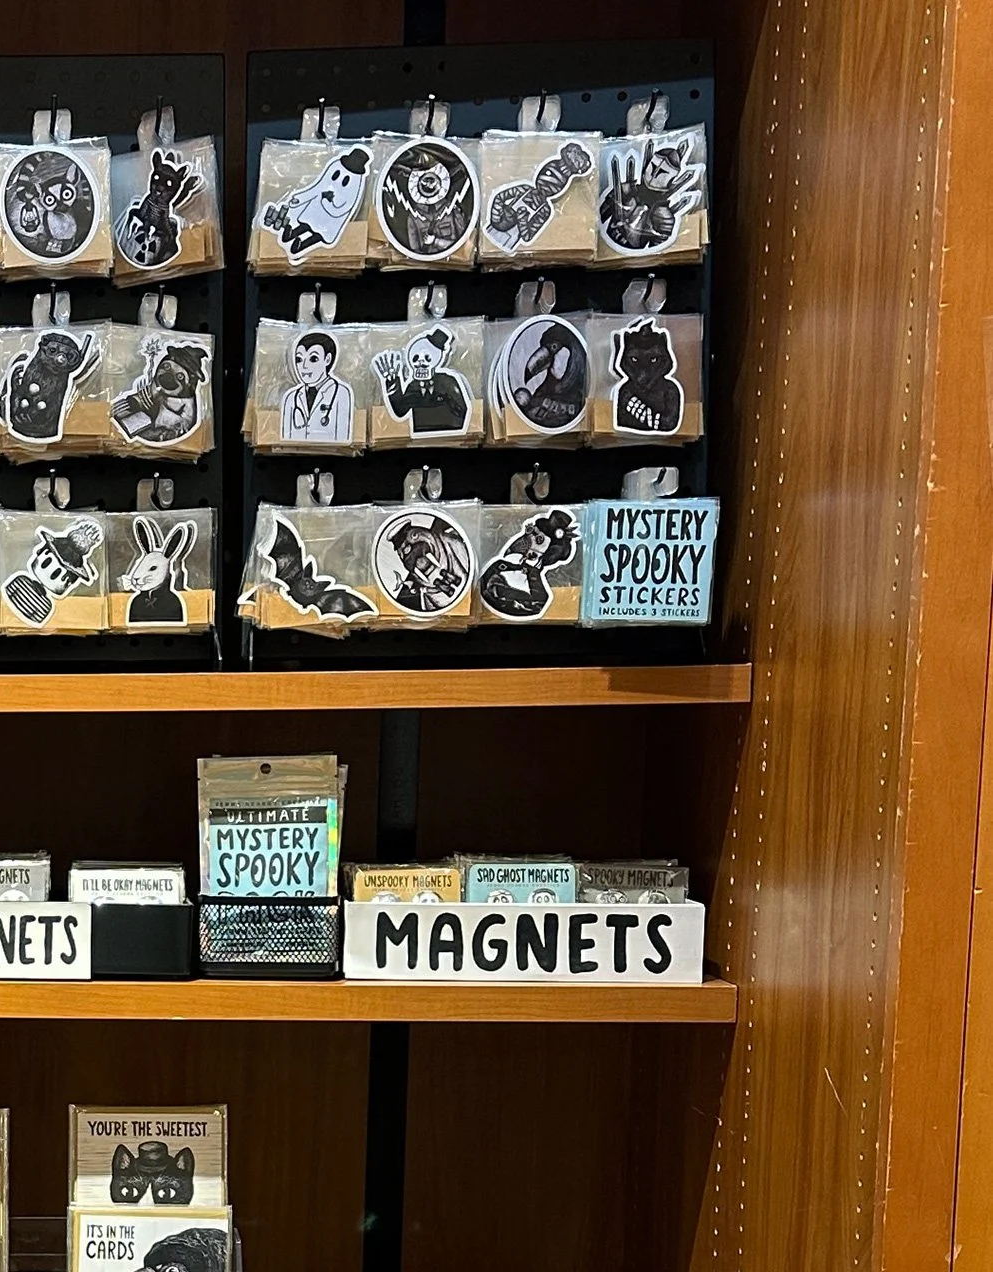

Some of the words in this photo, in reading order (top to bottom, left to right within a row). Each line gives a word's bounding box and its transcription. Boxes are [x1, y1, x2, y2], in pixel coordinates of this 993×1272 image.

[607, 508, 709, 540] MYSTERY
[600, 543, 706, 585] SPOOKY
[600, 586, 700, 606] STICKERS
[599, 607, 647, 616] INCLUDES
[651, 608, 657, 616] 3
[661, 608, 700, 617] STICKERS
[227, 807, 309, 823] ULTIMATE
[216, 827, 318, 851] MYSTERY
[216, 851, 320, 888] SPOOKY
[477, 868, 495, 882] SAD
[498, 868, 526, 883] GHOST
[528, 868, 570, 883] MAGNETS
[588, 867, 624, 884] SPOOKY
[627, 868, 674, 888] MAGNETS
[135, 879, 173, 891] MAGNETS
[364, 875, 409, 888] UNSPOOKY
[412, 875, 452, 888] MAGNETS
[376, 912, 672, 974] MAGNETS
[87, 1121, 127, 1136] YOU'RE
[131, 1121, 152, 1136] THE
[87, 1224, 103, 1238] IT'S
[107, 1225, 117, 1238] IN
[119, 1225, 135, 1239] THE
[86, 1241, 135, 1260] CARDS
